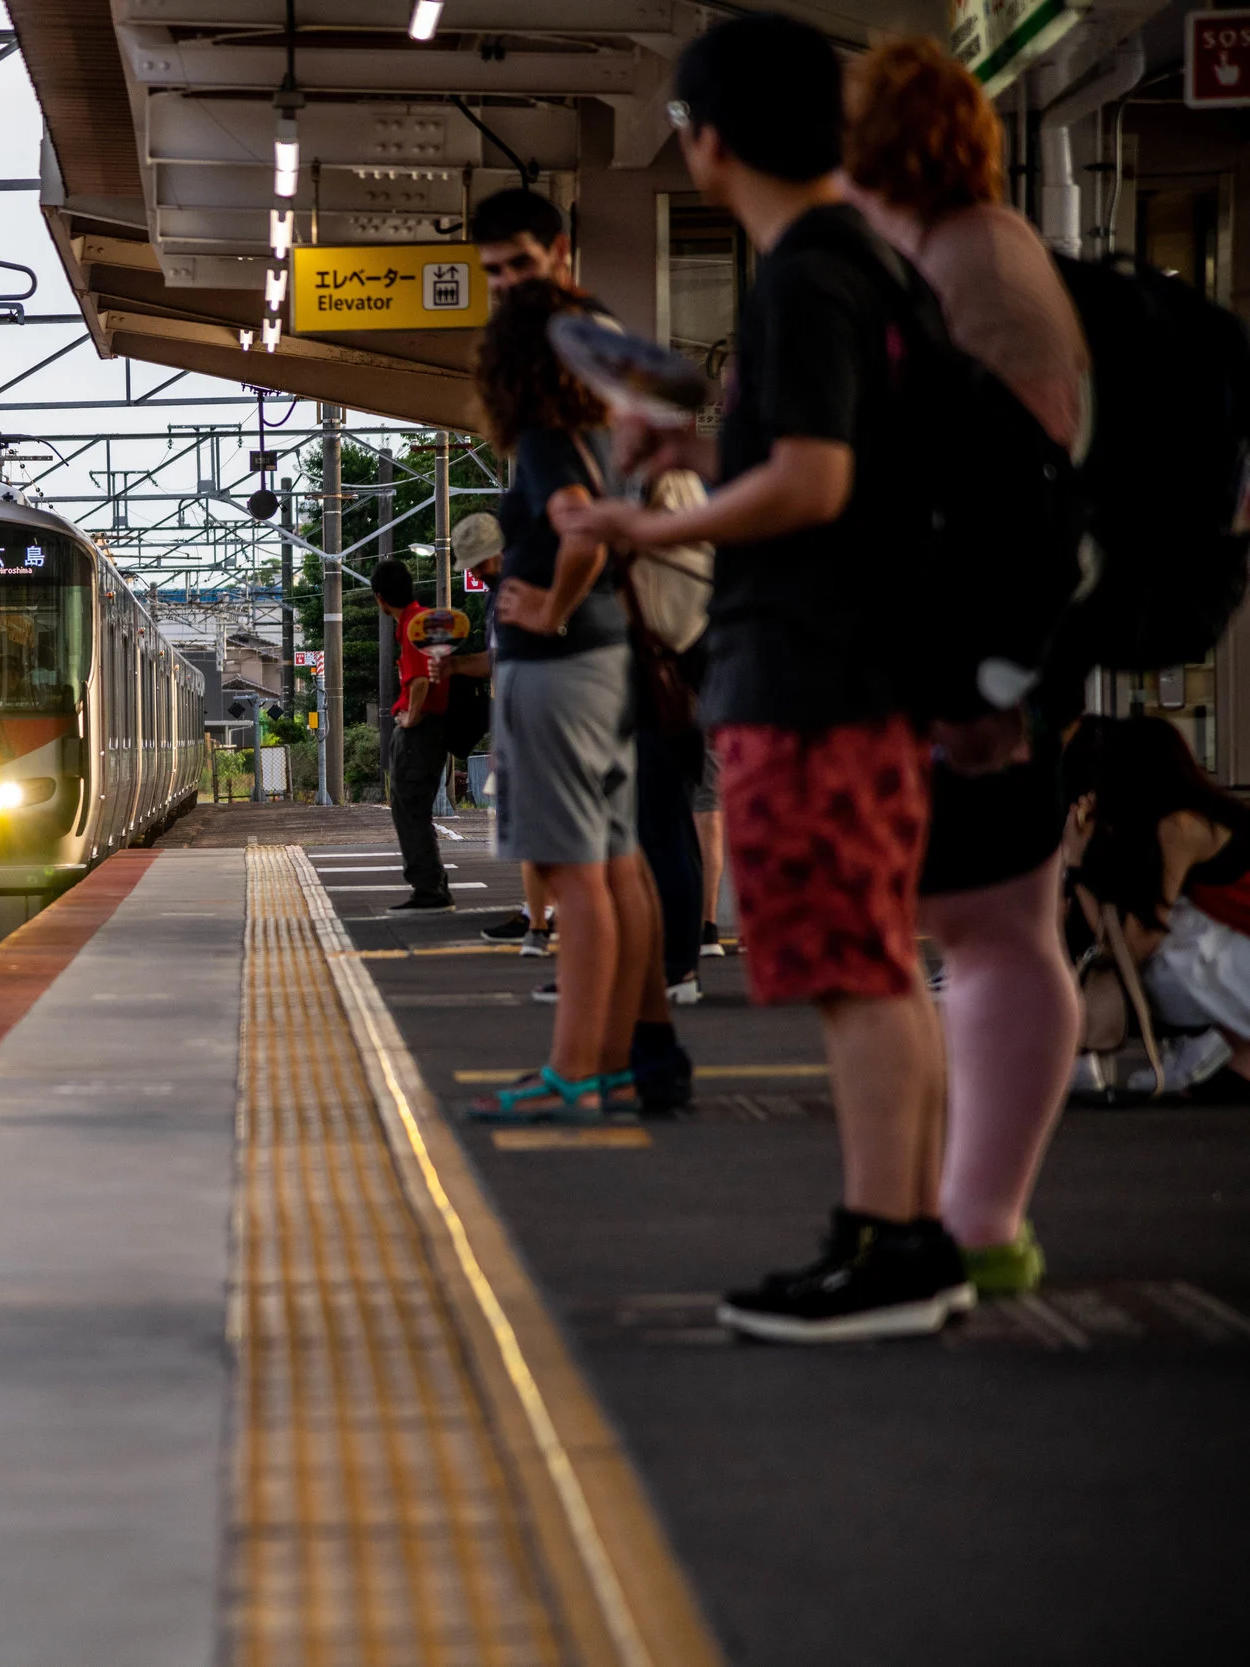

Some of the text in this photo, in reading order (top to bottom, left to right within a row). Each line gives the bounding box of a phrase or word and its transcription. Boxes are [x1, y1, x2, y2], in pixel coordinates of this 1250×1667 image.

[315, 268, 416, 289] エレベーター
[318, 294, 393, 311] Elevator
